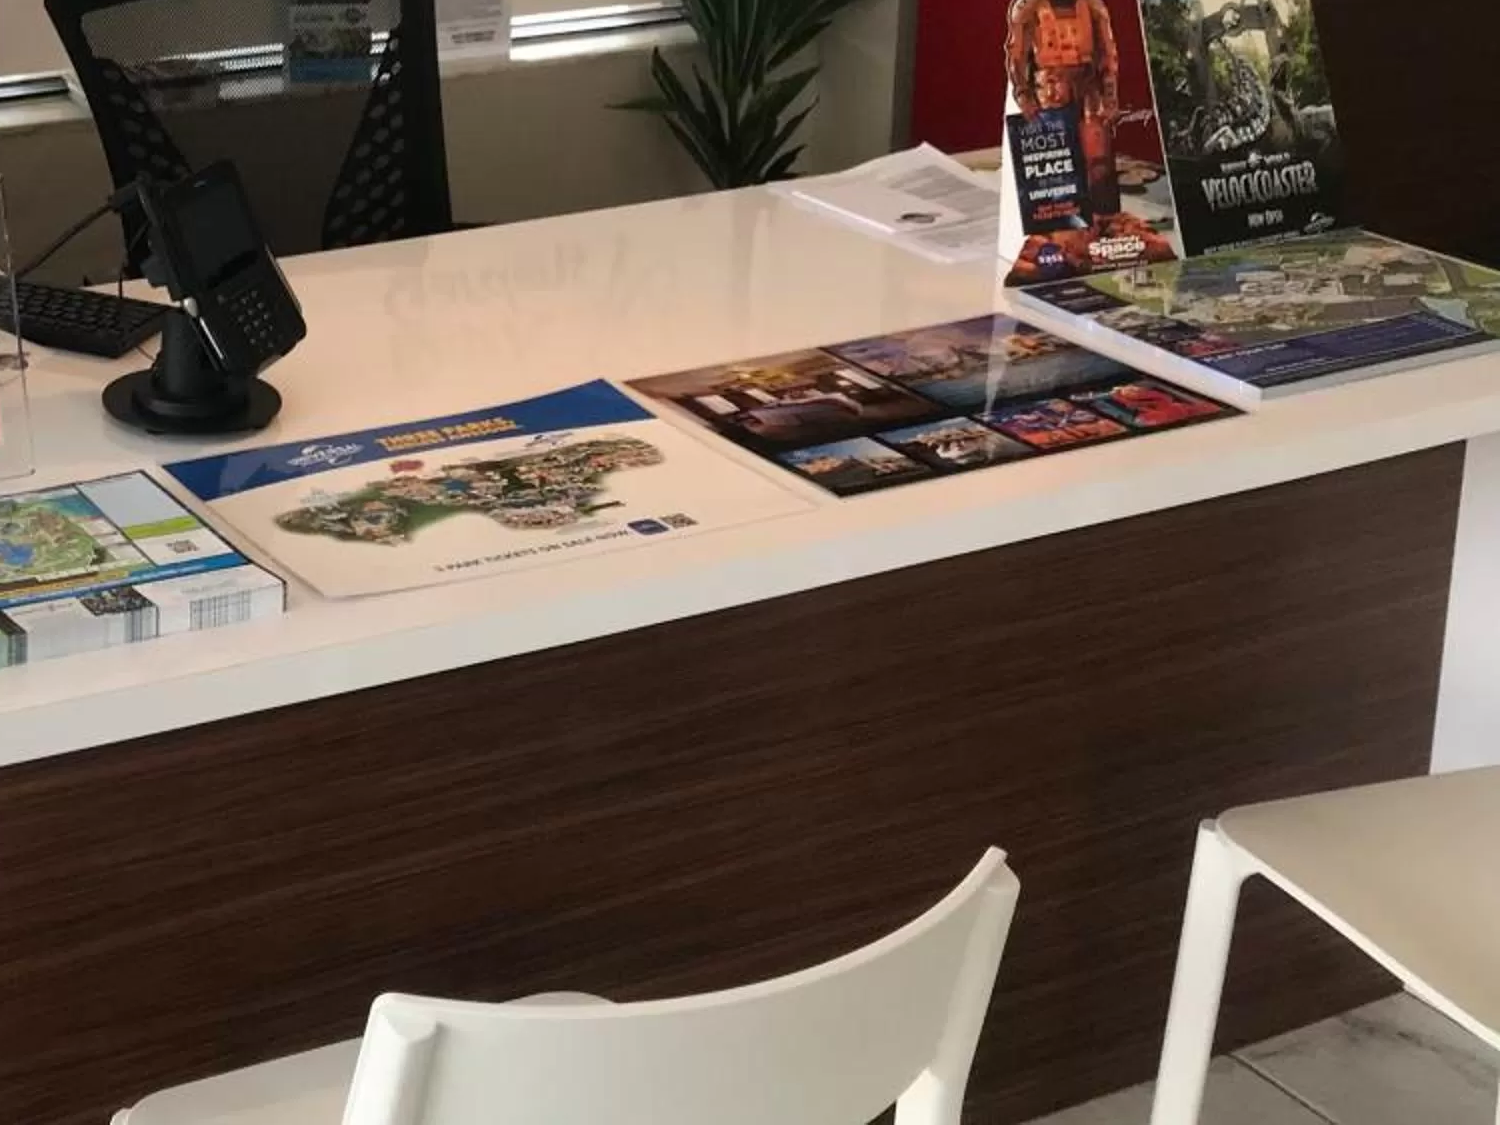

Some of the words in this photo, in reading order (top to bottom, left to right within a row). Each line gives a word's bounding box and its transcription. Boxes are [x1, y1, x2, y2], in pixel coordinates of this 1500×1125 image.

[1021, 132, 1067, 151] MOST
[1024, 160, 1074, 179] PLACE
[1088, 238, 1146, 258] Space
